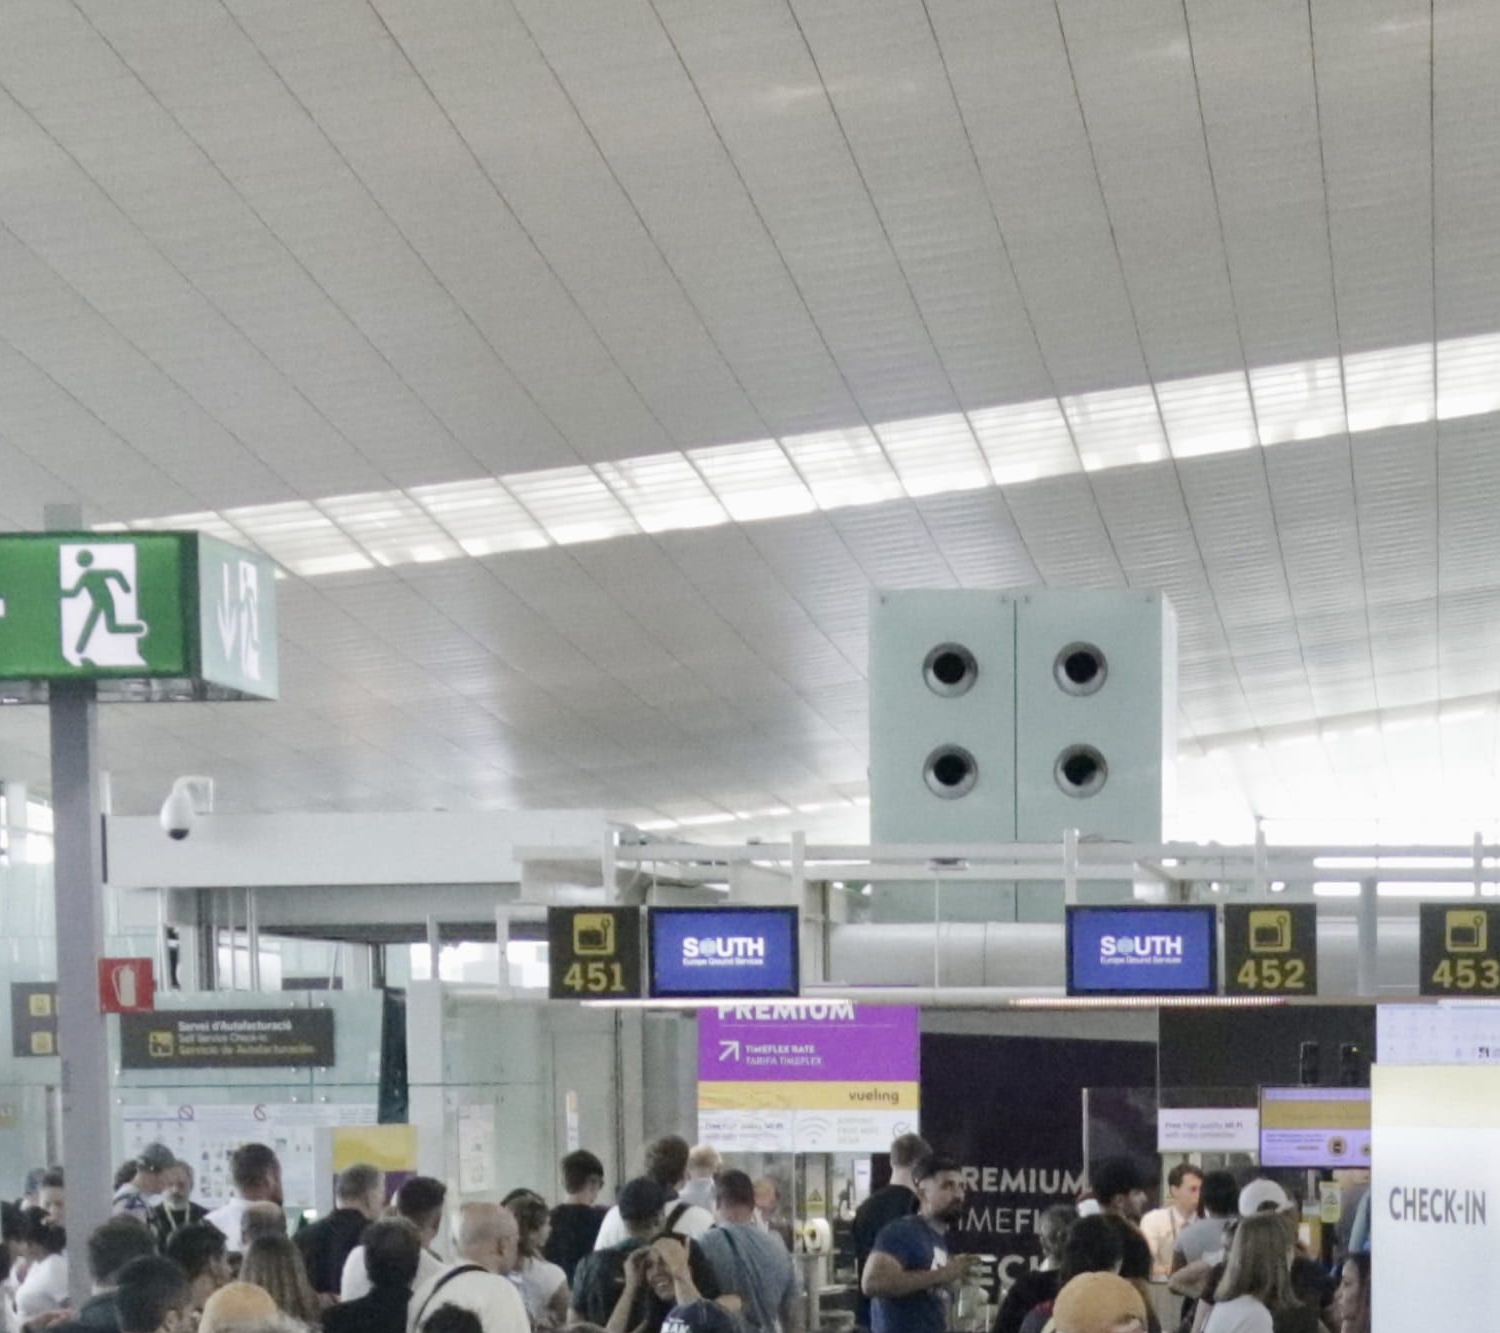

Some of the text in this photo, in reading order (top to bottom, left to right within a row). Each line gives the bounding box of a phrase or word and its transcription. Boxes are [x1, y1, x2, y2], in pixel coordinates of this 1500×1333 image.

[682, 936, 765, 958] SOUTH
[1100, 935, 1182, 956] SOUTH
[563, 962, 626, 992] 451
[1236, 959, 1305, 989] 452
[1432, 959, 1500, 989] 453
[849, 1088, 900, 1105] vueling
[960, 1166, 1087, 1195] REMIUM
[1389, 1186, 1487, 1225] CHECK-IN
